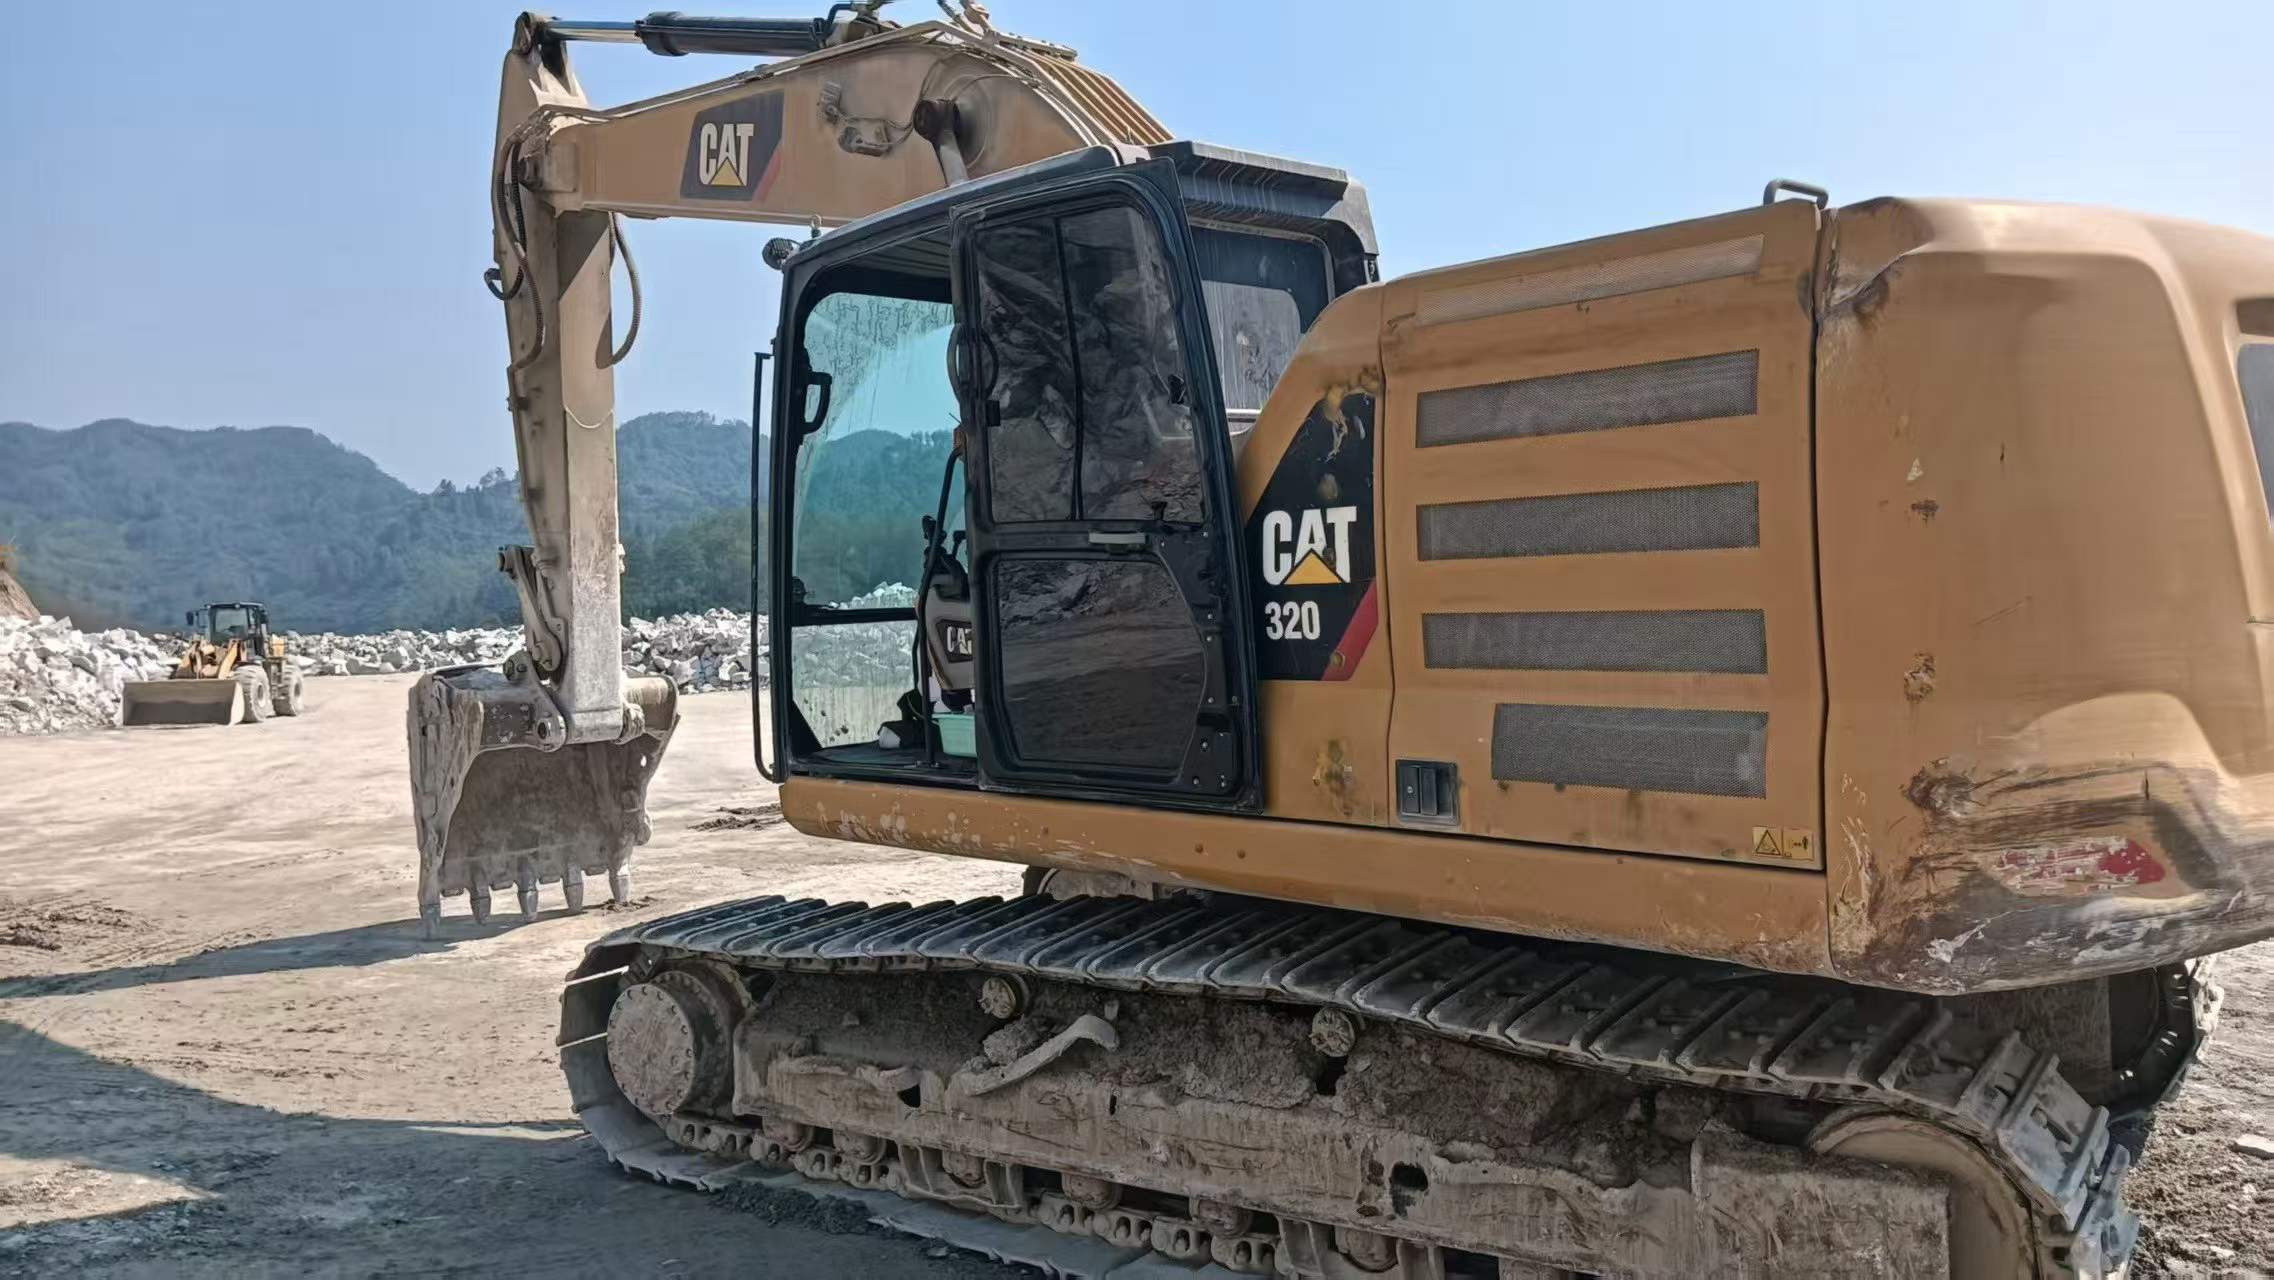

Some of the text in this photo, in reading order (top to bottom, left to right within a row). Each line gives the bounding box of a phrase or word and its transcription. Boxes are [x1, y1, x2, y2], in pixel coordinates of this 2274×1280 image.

[700, 122, 754, 187] CAT
[1262, 506, 1357, 586] CAT
[1264, 601, 1321, 640] 320
